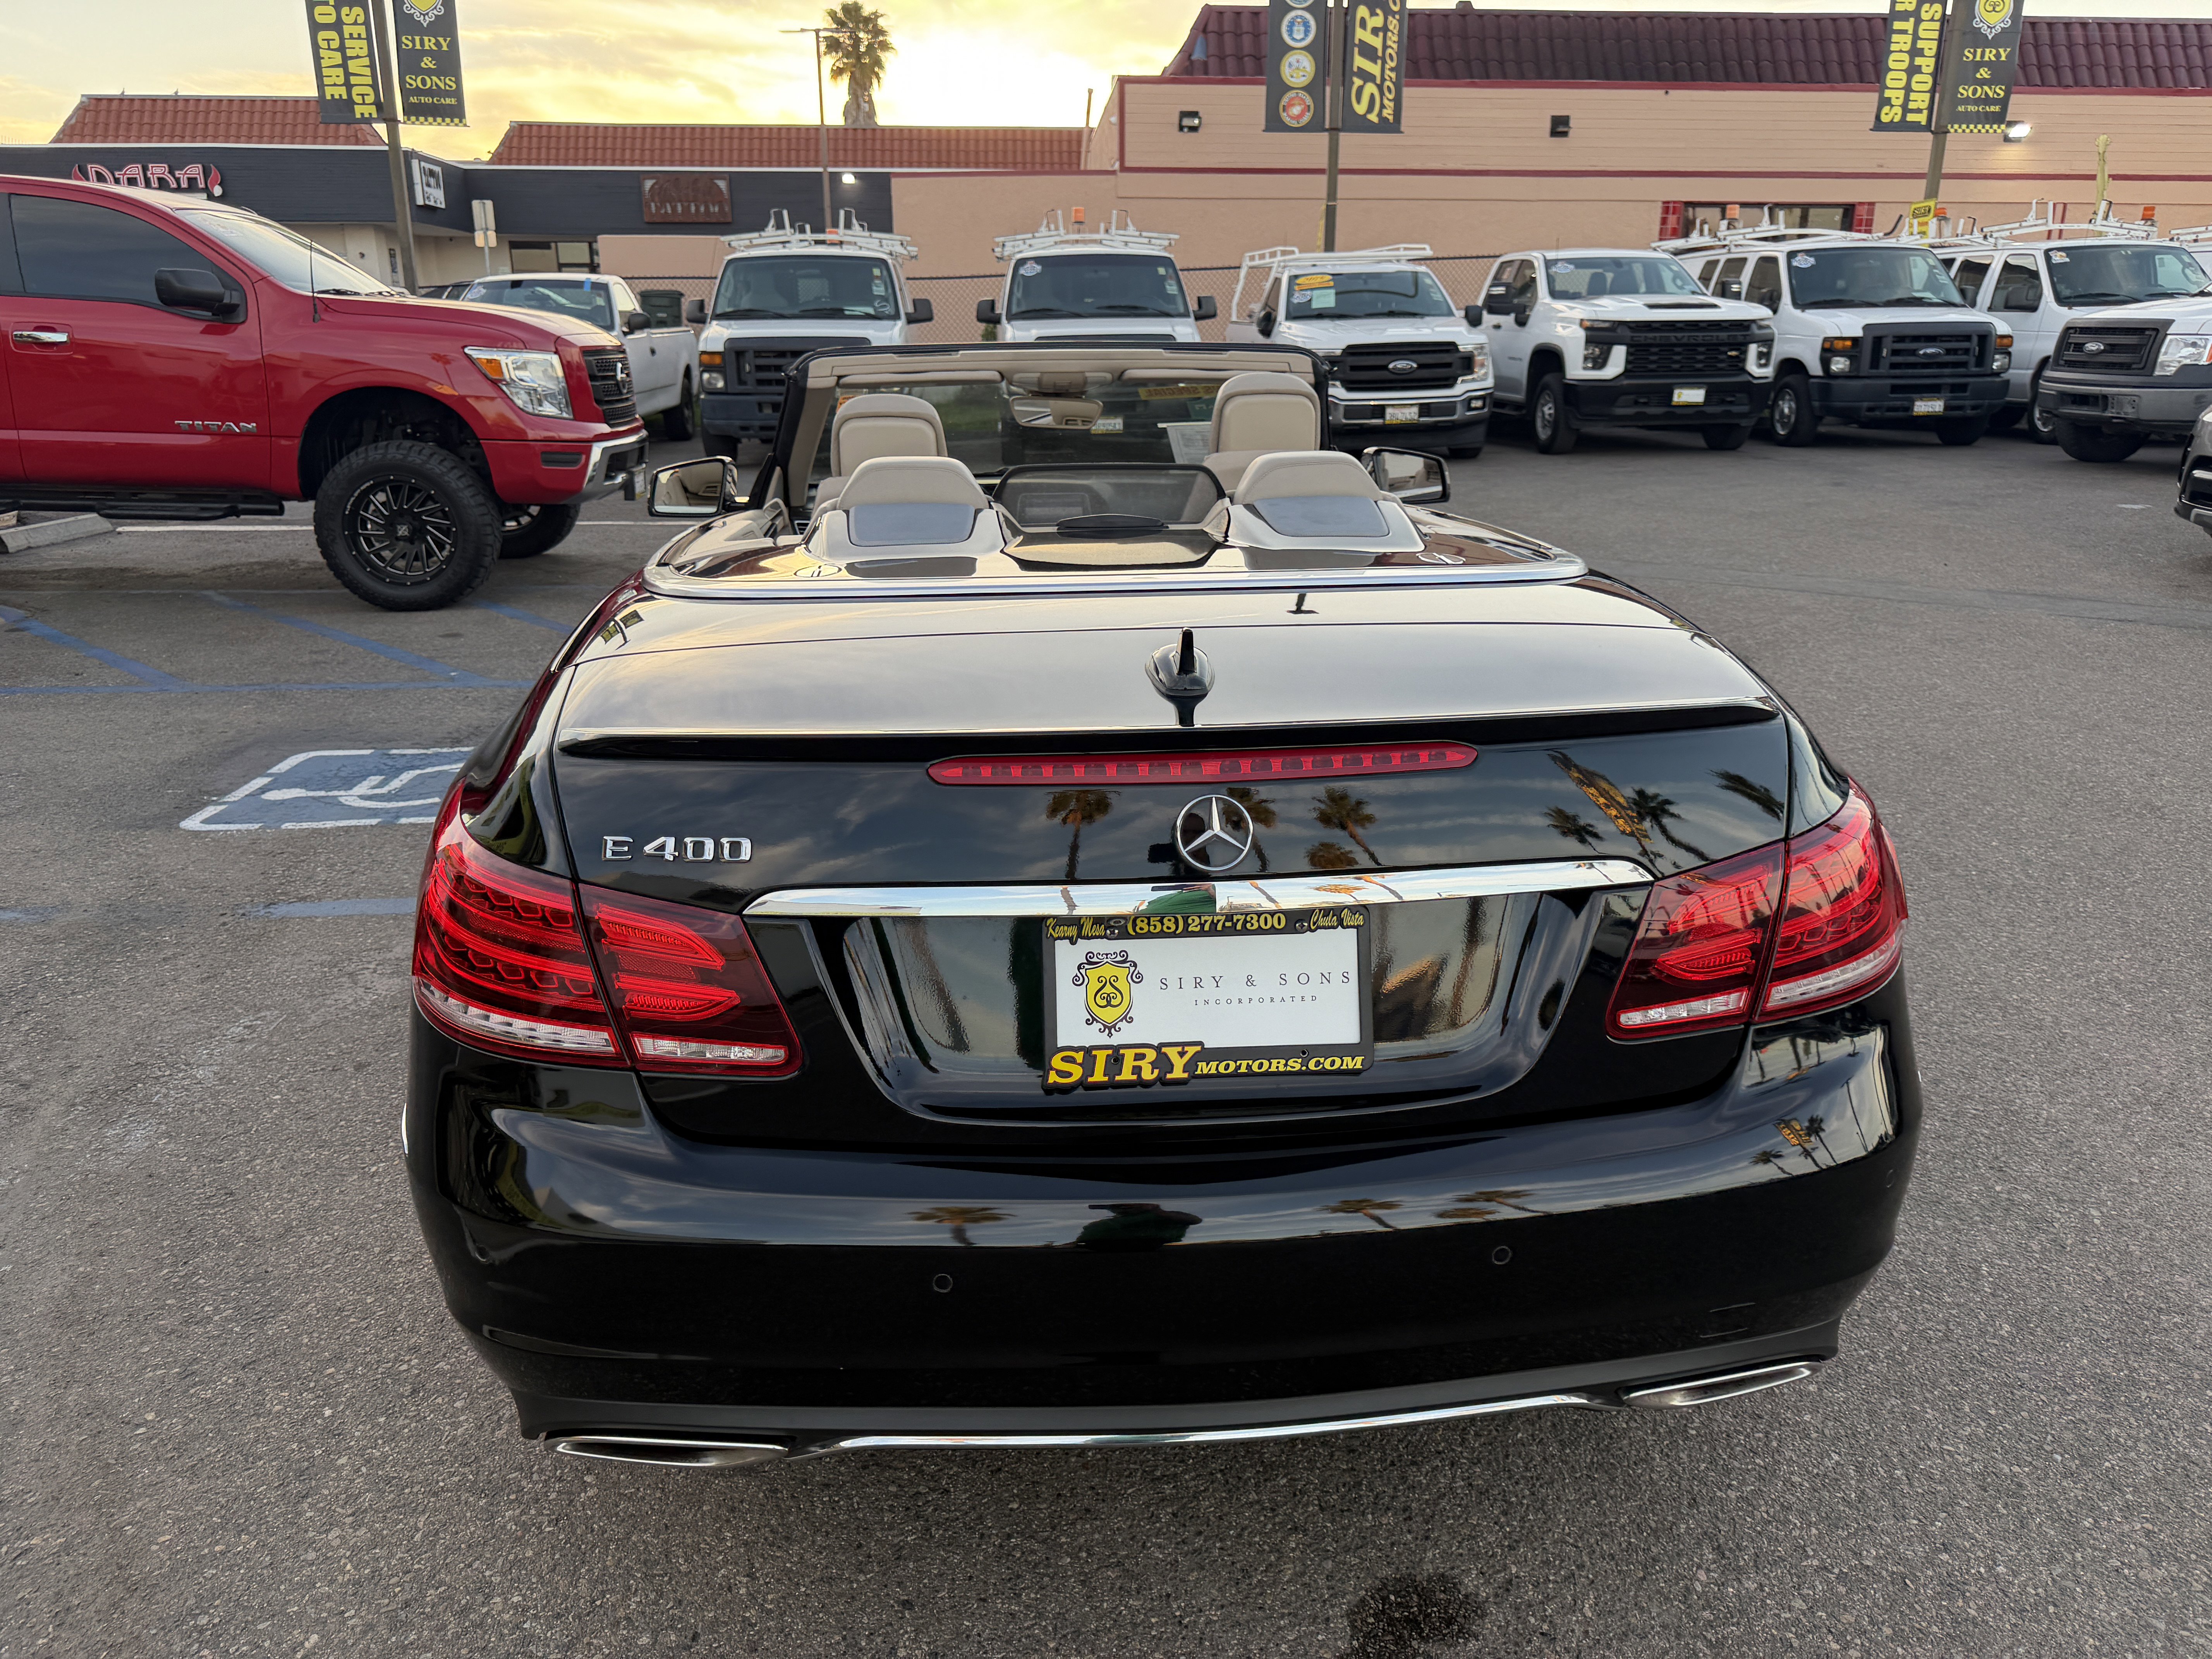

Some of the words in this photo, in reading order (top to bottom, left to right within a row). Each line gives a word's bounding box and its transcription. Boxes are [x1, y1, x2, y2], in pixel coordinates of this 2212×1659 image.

[402, 36, 451, 51] SIRY
[341, 7, 378, 118] SERVICE
[421, 57, 437, 69] &
[1963, 48, 2011, 61] SIRY
[317, 31, 347, 100] CARE
[1880, 17, 1915, 123] TROOPS
[1906, 3, 1942, 125] SUPPORT
[1976, 67, 1992, 79] &
[405, 75, 457, 90] SONS
[1957, 85, 2005, 98] SONS
[87, 164, 206, 189] DARA
[175, 420, 257, 433] TITAN
[601, 836, 634, 862] E
[642, 836, 752, 864] 400
[1047, 918, 1077, 942] Kearny
[1080, 916, 1105, 937] Mesa
[1127, 915, 1183, 935] (858)
[1188, 913, 1286, 932] 277-7300
[1310, 910, 1338, 929] Chula
[1341, 908, 1364, 926] Vista
[1160, 975, 1224, 991] SIRY
[1245, 974, 1257, 987] &
[1279, 970, 1350, 986] SONS
[1194, 995, 1318, 1006] INCORPORATED
